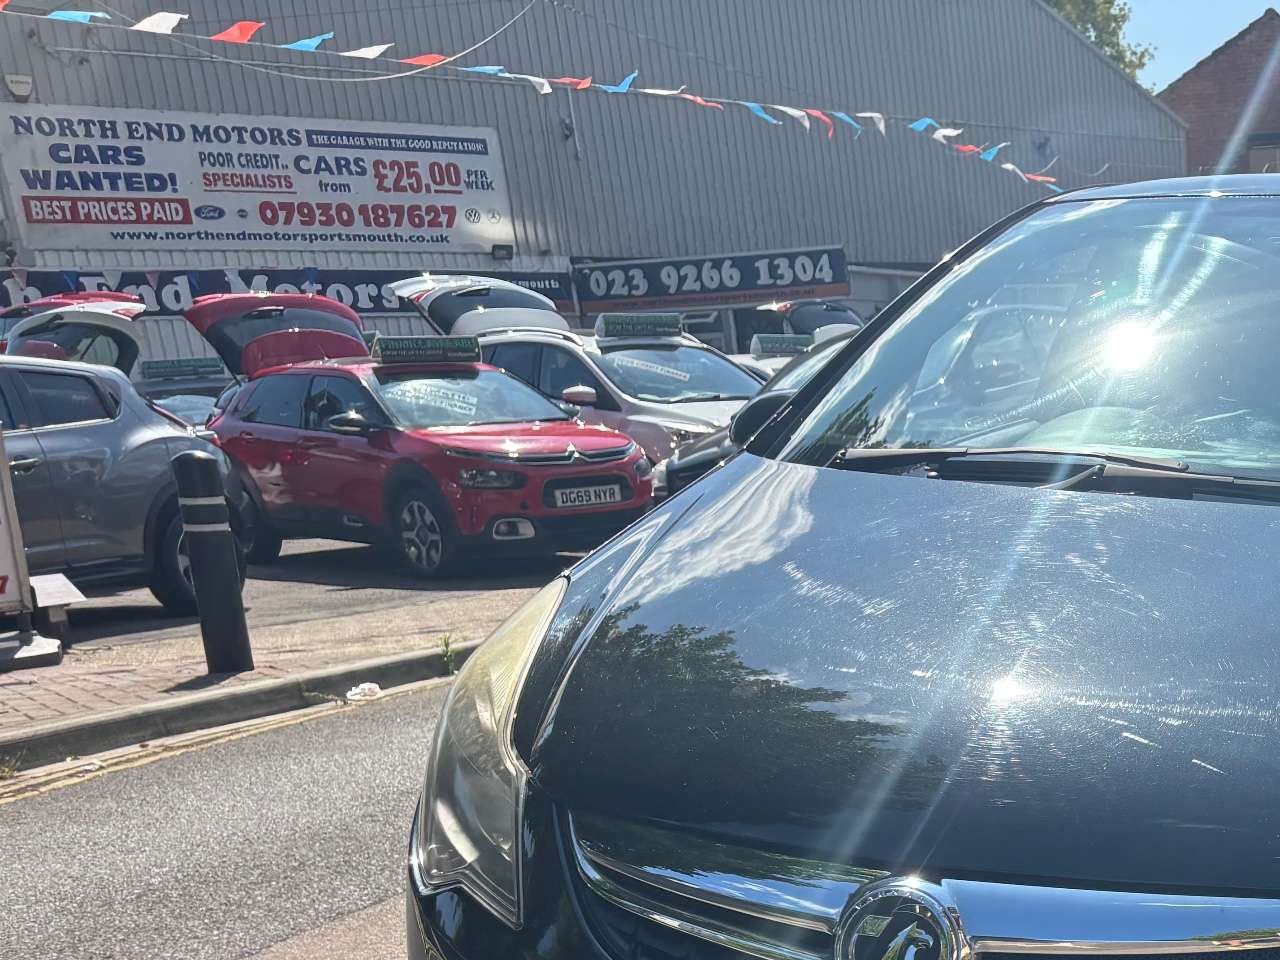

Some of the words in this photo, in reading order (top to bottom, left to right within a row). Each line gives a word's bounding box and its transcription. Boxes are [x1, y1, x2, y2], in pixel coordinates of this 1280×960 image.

[10, 115, 121, 139] NORTH
[125, 120, 186, 142] END
[191, 124, 303, 146] MOTORS
[312, 134, 330, 144] THE
[331, 136, 366, 146] GARAGE
[367, 137, 389, 147] WITH
[390, 138, 407, 148] THE
[409, 140, 431, 149] GOOD
[49, 143, 146, 166] CARS
[199, 151, 235, 168] POOR
[293, 155, 368, 177] CARS
[467, 169, 489, 180] PER
[20, 168, 180, 193] WANTED!
[202, 172, 294, 189] SPECIALISTS
[372, 159, 463, 194] £25.00
[464, 180, 496, 191] WEEK
[318, 180, 352, 193] from
[30, 200, 72, 220] BEST
[78, 201, 137, 221] PRICES
[142, 202, 184, 221] PAID
[259, 200, 355, 227] 07930
[358, 203, 457, 229] 187627
[110, 230, 450, 245] www.northendmotorsportsmouth.co.uk
[590, 267, 649, 296] 023
[660, 259, 741, 294] 9266
[754, 253, 833, 286] 1304
[560, 489, 592, 504] DG69
[594, 487, 616, 502] NYR
